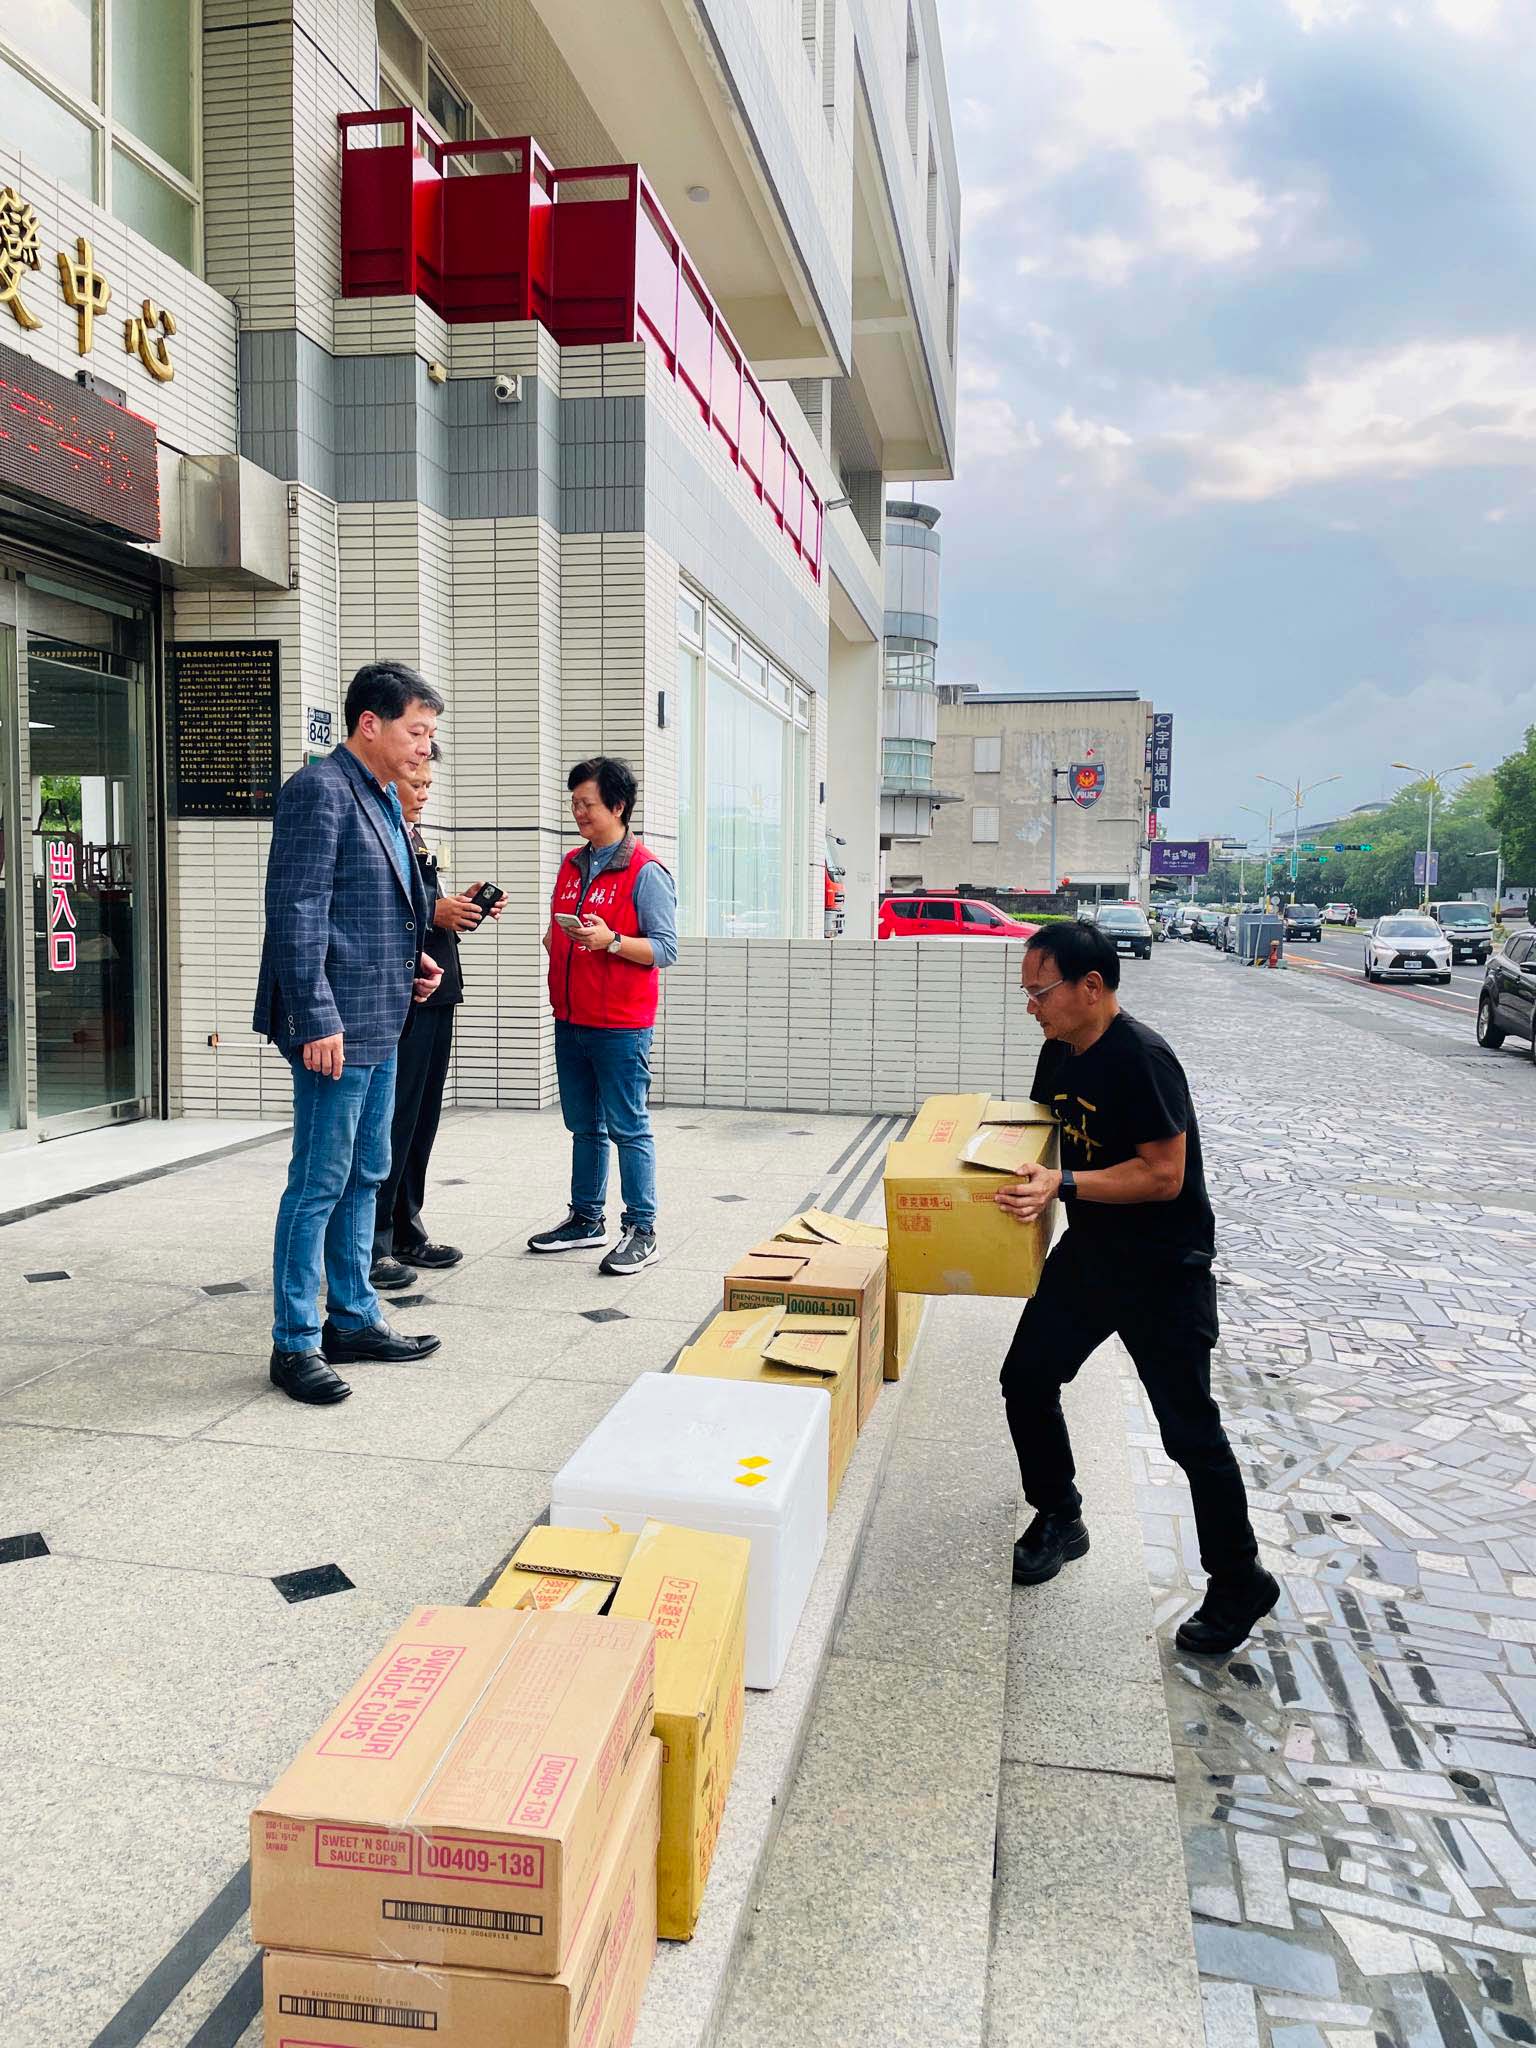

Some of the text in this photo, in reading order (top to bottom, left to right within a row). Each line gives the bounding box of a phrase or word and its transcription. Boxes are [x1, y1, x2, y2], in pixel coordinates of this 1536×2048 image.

[310, 722, 330, 744] 842
[1154, 730, 1170, 792] 宇信通訊
[1076, 791, 1098, 799] POLICE
[50, 841, 76, 971] 出入口
[732, 1293, 781, 1304] FRENCH FRIED
[791, 1299, 851, 1316] 00004-191
[407, 1649, 455, 1693] SWEET
[340, 1657, 421, 1740] SAUCE CUPS
[394, 1696, 424, 1710] 'N
[361, 1713, 411, 1754] SOUR
[520, 1760, 567, 1823] 00409-138
[322, 1834, 406, 1853] SWEET 'N SOUR
[330, 1850, 397, 1866] SAUCE CUPS
[427, 1845, 535, 1877] 00409-138
